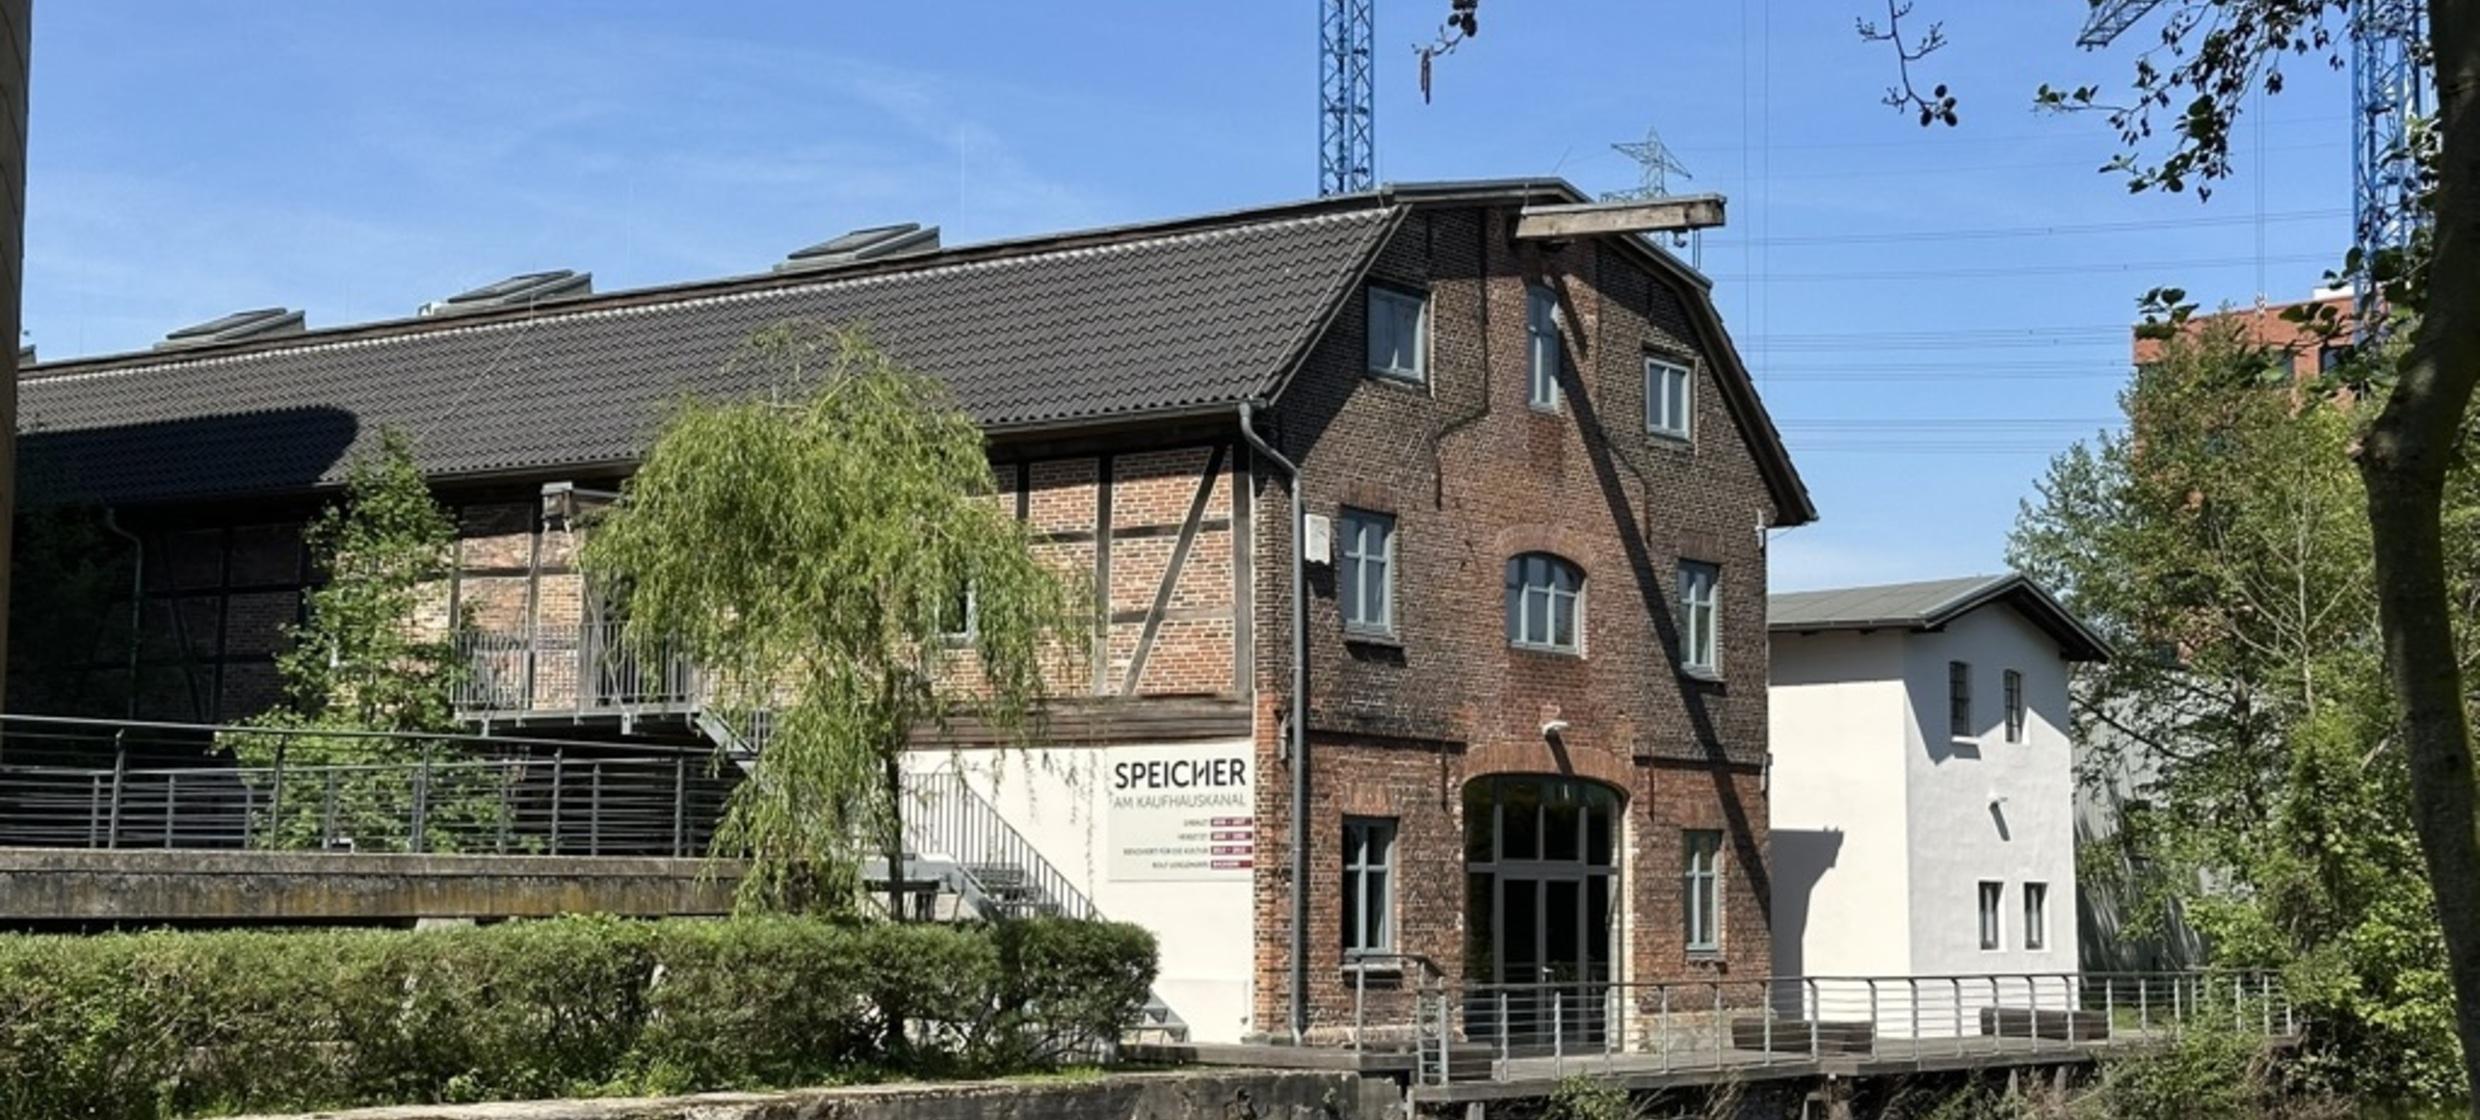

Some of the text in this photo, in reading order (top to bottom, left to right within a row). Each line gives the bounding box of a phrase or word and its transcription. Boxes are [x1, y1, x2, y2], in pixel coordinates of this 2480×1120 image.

[1115, 758, 1246, 789] SPEICHER
[1114, 793, 1246, 809] AM KAUFHAUSKANAL
